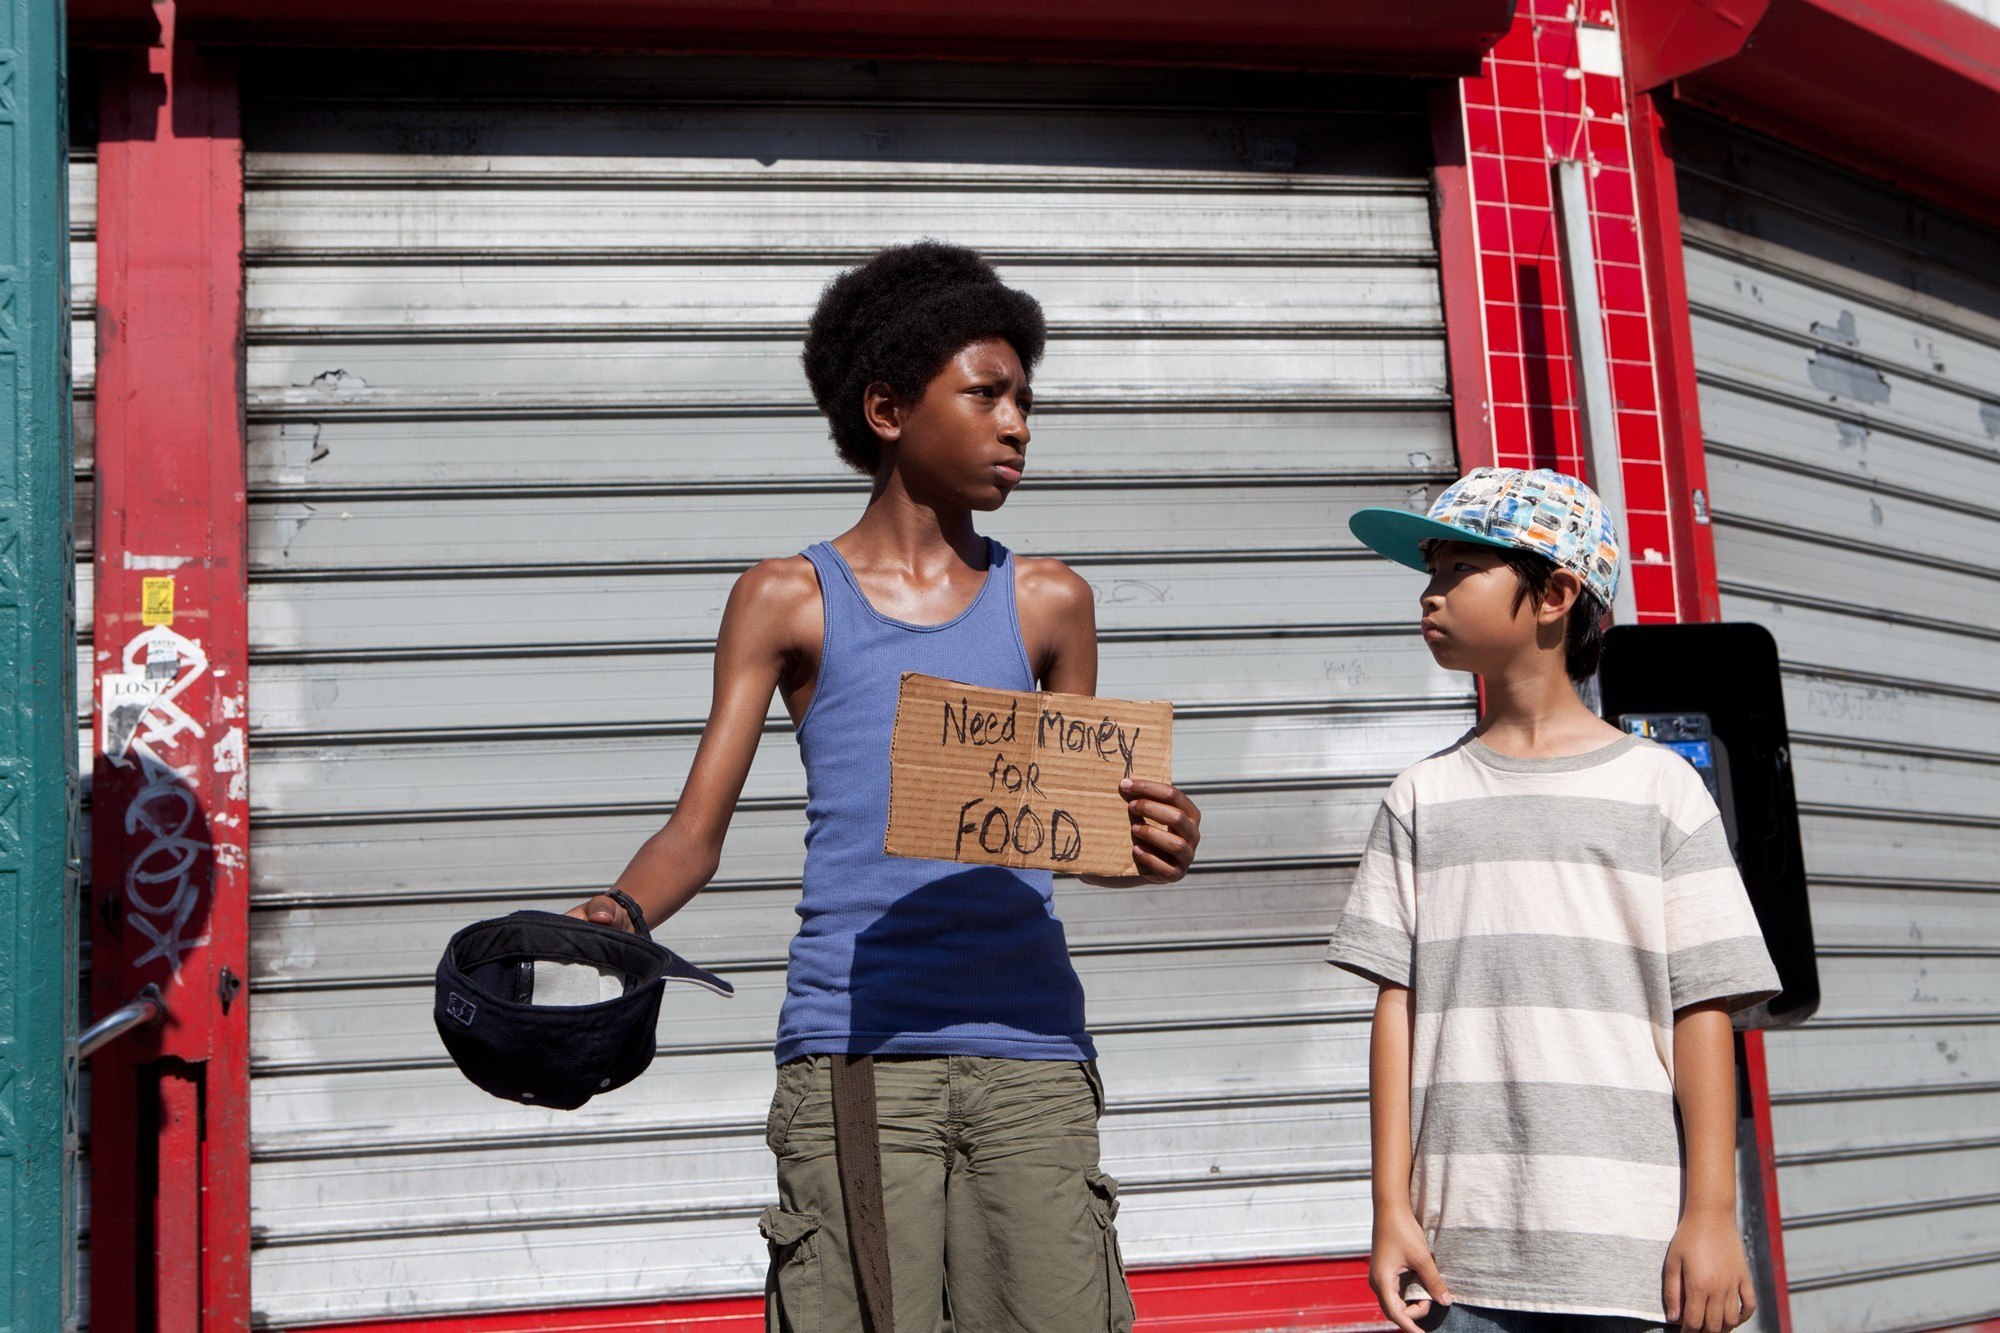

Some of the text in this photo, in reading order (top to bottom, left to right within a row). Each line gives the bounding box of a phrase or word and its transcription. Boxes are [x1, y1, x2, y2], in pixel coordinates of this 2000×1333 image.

[114, 681, 161, 696] LOST
[942, 697, 1140, 779] Need Money
[955, 798, 1082, 862] FOOD
